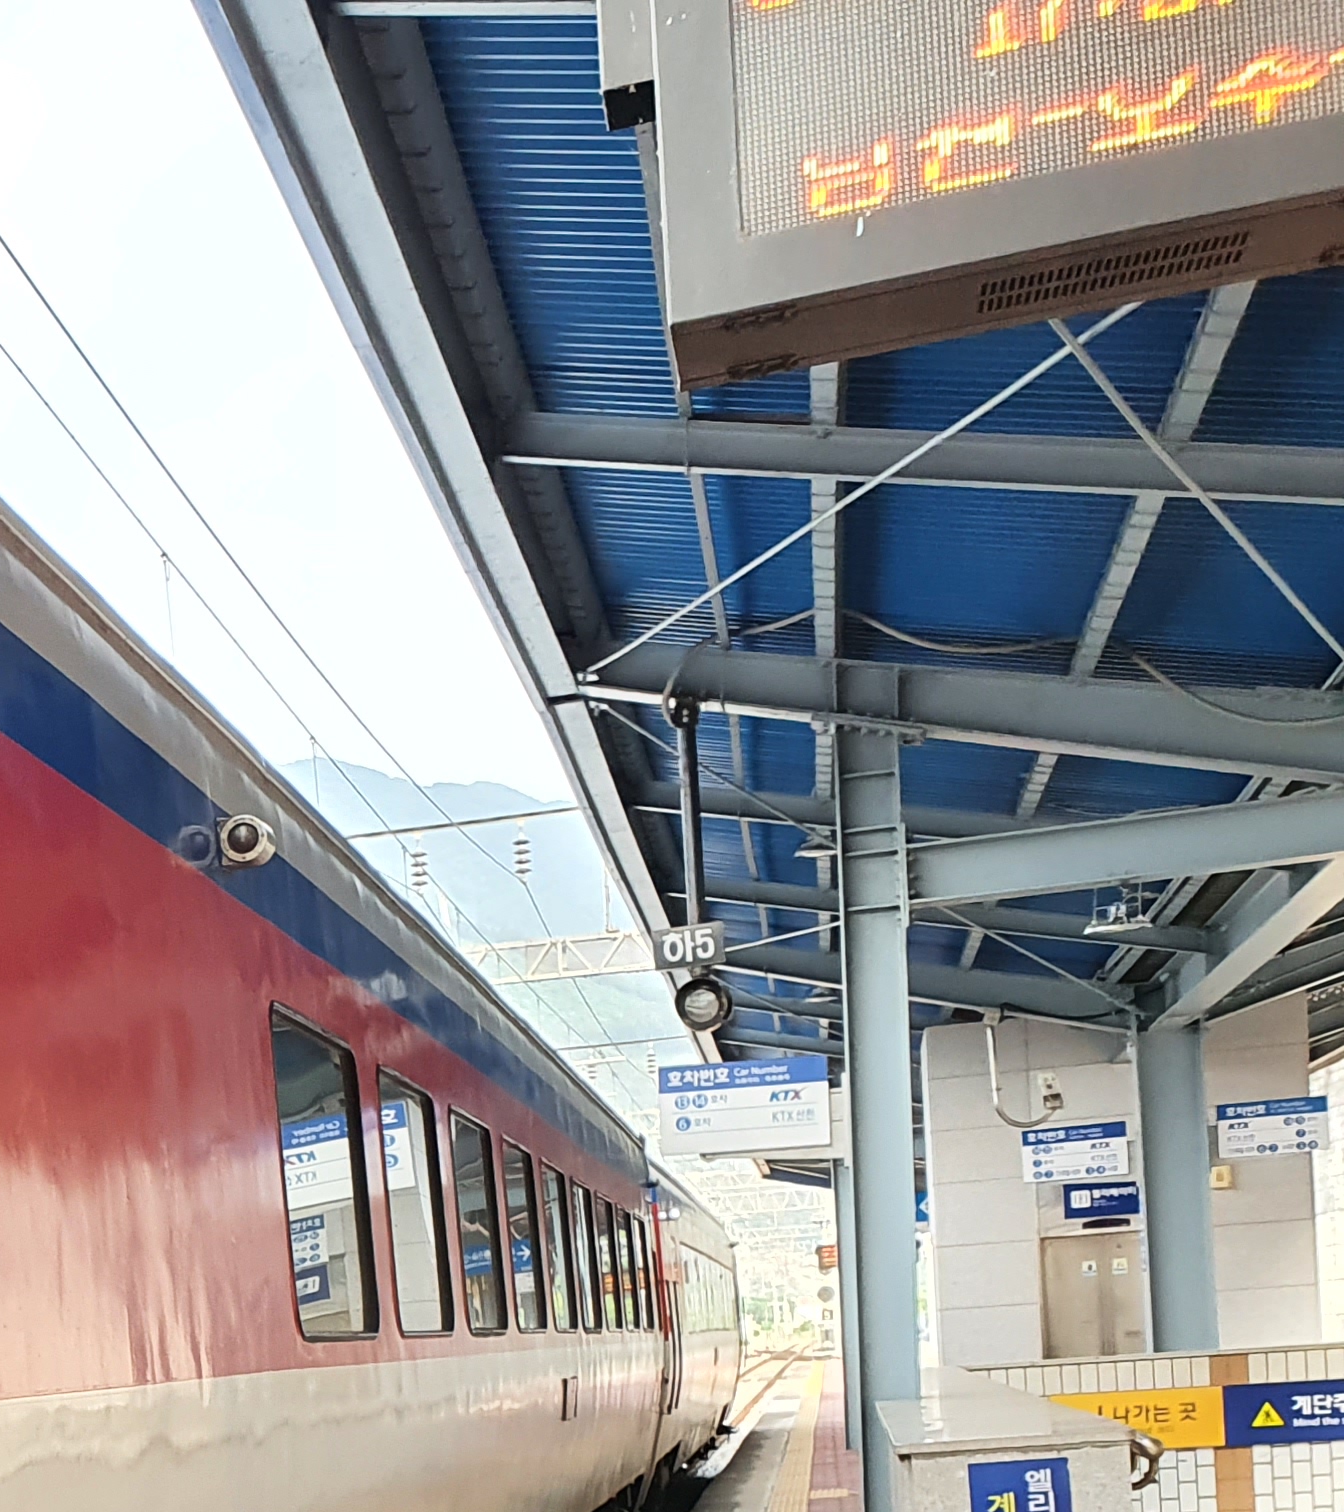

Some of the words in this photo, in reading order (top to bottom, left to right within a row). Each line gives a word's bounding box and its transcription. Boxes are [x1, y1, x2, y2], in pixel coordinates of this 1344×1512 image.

[662, 928, 715, 962] 하5
[667, 1067, 730, 1087] 호차번호
[769, 1087, 808, 1103] KTX
[771, 1110, 794, 1123] KTX
[1112, 1404, 1170, 1424] 나가는
[1178, 1402, 1197, 1421] 곳
